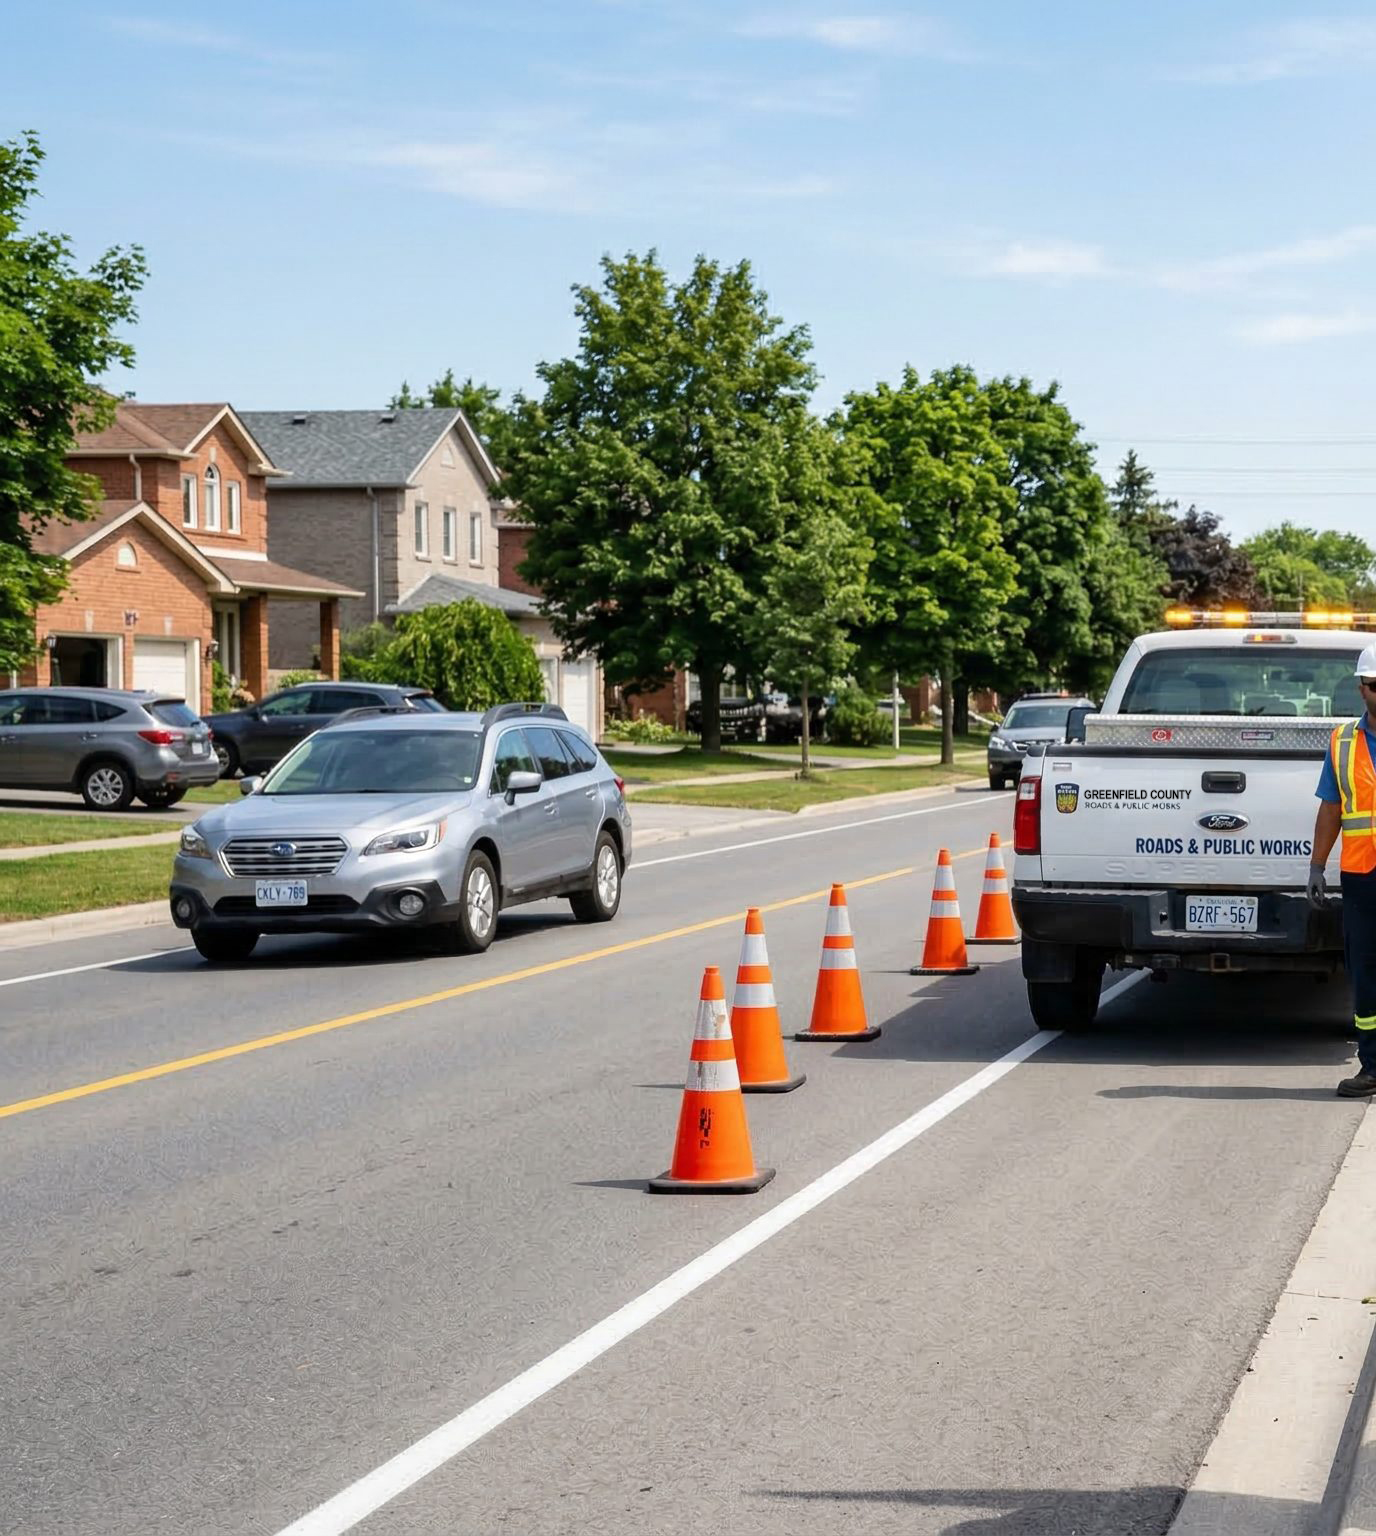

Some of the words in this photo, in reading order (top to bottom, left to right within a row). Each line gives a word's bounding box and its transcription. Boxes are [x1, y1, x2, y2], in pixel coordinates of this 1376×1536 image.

[1084, 789, 1148, 800] GREENFIELD
[1150, 789, 1192, 800] COUNTY
[1208, 815, 1237, 828] Ford
[1135, 838, 1184, 854] ROADS
[1187, 838, 1199, 854] &
[1203, 839, 1255, 855] PUBLIC
[1259, 840, 1312, 856] WORKS
[257, 887, 281, 901] CXLY
[1189, 905, 1222, 923] BZRF
[1230, 906, 1255, 924] 567
